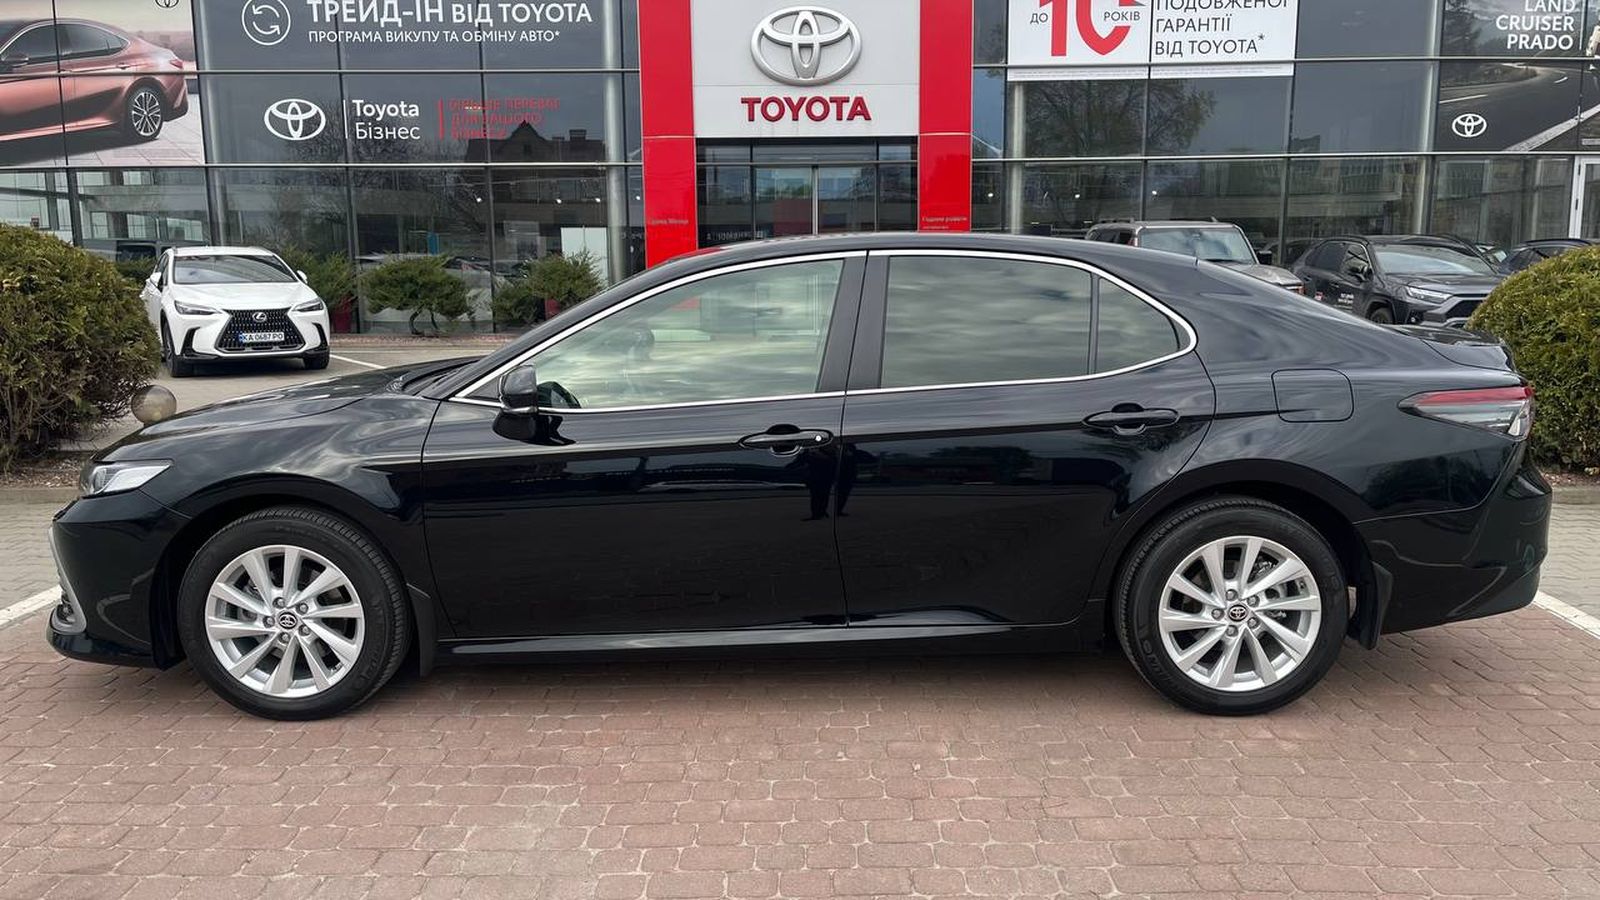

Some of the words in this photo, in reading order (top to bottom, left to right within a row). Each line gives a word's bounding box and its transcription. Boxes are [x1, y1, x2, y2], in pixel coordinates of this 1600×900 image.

[451, 3, 494, 27] ВІД
[497, 2, 593, 23] TOYOTA
[1524, 0, 1576, 13] LAND
[1029, 12, 1049, 25] ДО
[1102, 10, 1141, 22] РОКІВ
[1155, 13, 1233, 33] ГАРАНТІЇ
[1495, 14, 1575, 32] CRUISER
[308, 30, 383, 43] ПРОГРАМА
[385, 30, 440, 43] ВИКУПУ
[442, 30, 460, 43] ТА
[461, 30, 517, 43] ОБМІНУ
[1506, 33, 1574, 50] PRADO
[1154, 40, 1184, 58] ВІД
[352, 99, 420, 121] Toyota
[740, 95, 872, 122] TOYOTA
[355, 121, 421, 141] Бізнес
